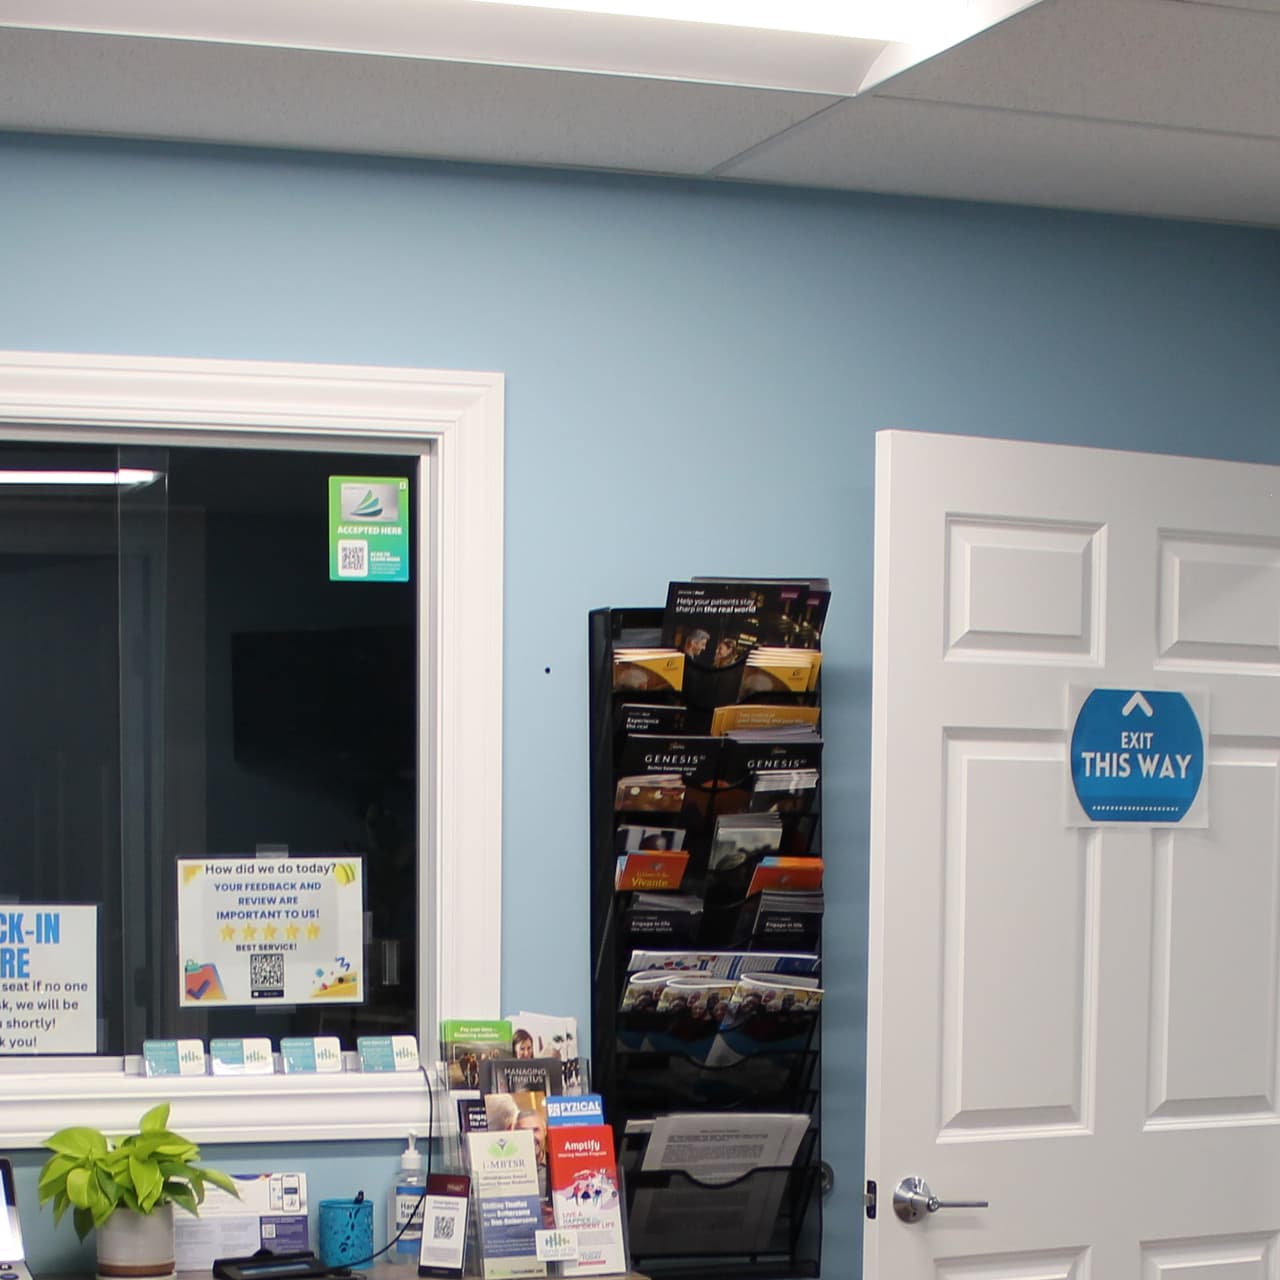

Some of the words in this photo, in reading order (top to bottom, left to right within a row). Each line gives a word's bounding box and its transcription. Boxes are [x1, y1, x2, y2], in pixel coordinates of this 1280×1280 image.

[337, 526, 380, 535] ACCEPTED
[381, 526, 402, 536] HERE
[677, 597, 693, 605] Help
[694, 598, 710, 607] your
[710, 597, 739, 606] patients
[740, 598, 755, 607] stay
[675, 606, 695, 614] sharp
[735, 605, 756, 613] world
[1121, 731, 1154, 749] EXIT
[645, 754, 699, 764] GENESIS
[747, 759, 800, 769] GENESIS
[1081, 752, 1131, 778] THIS
[1136, 753, 1192, 779] WAY
[205, 864, 232, 875] How
[236, 863, 255, 874] did
[258, 866, 275, 874] we
[277, 863, 293, 874] do
[296, 862, 336, 876] today?
[214, 883, 243, 892] YOUR
[245, 882, 297, 892] FEEDBACK
[299, 881, 322, 891] AND
[631, 877, 668, 887] Vivante
[238, 897, 277, 906] REVIEW
[279, 896, 299, 905] ARE
[216, 910, 281, 920] IMPORTANT
[284, 910, 299, 920] TO
[301, 909, 320, 919] US!
[236, 943, 256, 952] BEST
[258, 943, 297, 951] SERVICE!
[2, 981, 29, 992] seat
[32, 980, 42, 992] if
[45, 983, 61, 992] no
[64, 983, 88, 992] one
[16, 1001, 34, 1010] we
[37, 999, 59, 1010] will
[63, 999, 79, 1010] be
[6, 1017, 56, 1032] shortly!
[9, 1036, 37, 1049] you!
[504, 1067, 547, 1076] MANAGING
[509, 1075, 544, 1084] TINNITUS
[561, 1101, 601, 1112] FYZICAL
[564, 1139, 601, 1152] Amptify
